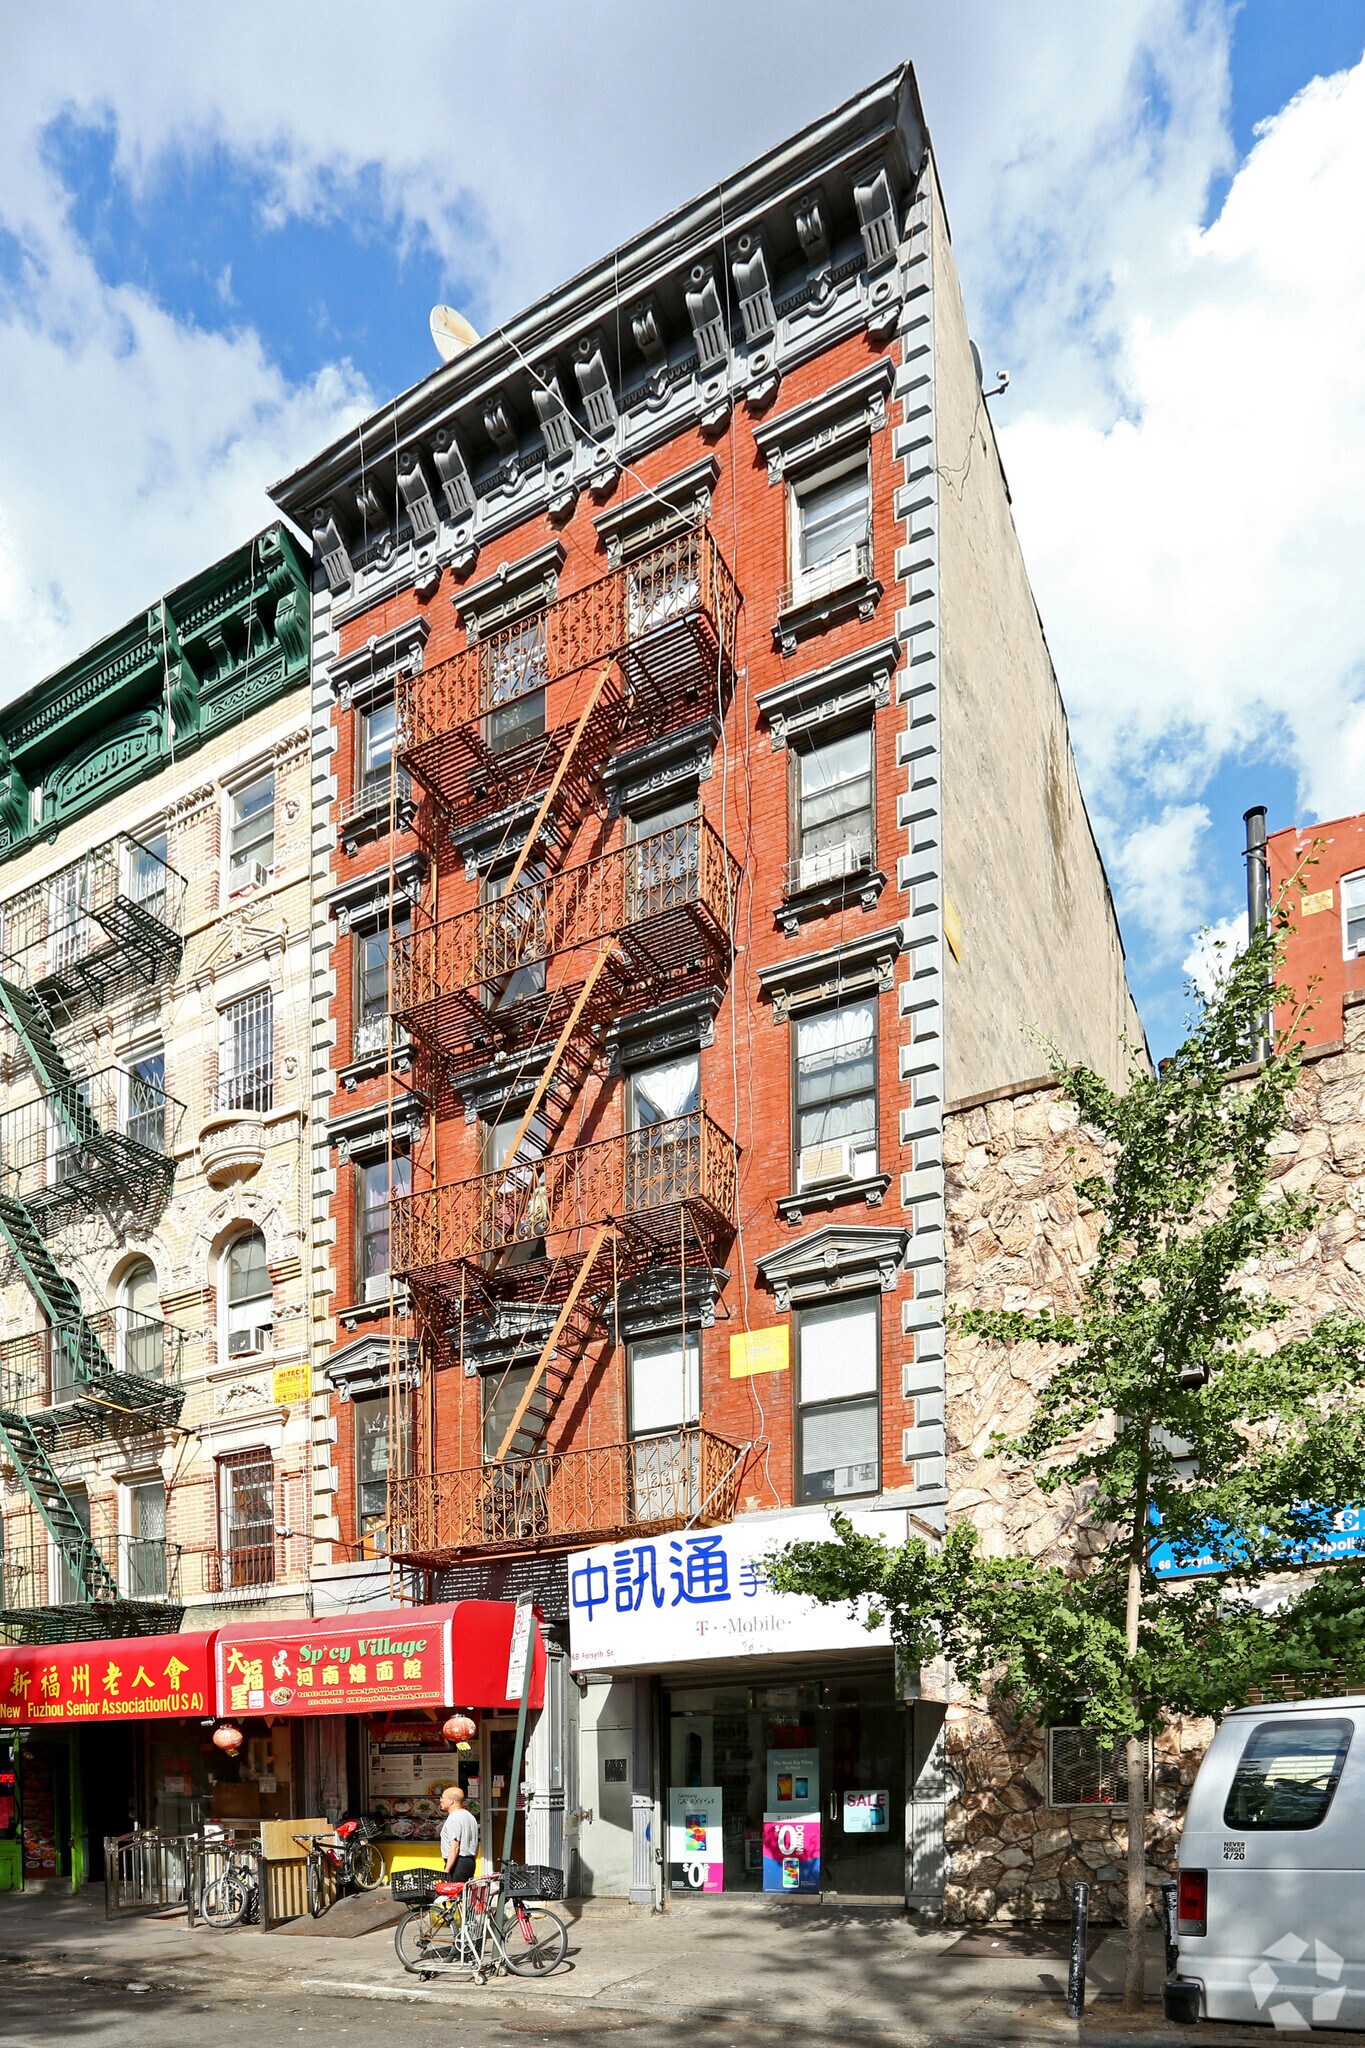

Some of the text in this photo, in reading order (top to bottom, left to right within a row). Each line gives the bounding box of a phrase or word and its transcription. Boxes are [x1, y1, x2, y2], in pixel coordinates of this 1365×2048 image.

[74, 741, 132, 791] MAJOR
[1158, 1560, 1171, 1570] 66
[572, 1535, 731, 1621] 中訊通
[358, 1637, 428, 1658] Village
[10, 1655, 190, 1701] 新福州老人會
[0, 1703, 20, 1719] New
[28, 1702, 64, 1718] Fuzhou
[66, 1699, 100, 1716] Senior
[847, 1793, 886, 1807] SALE
